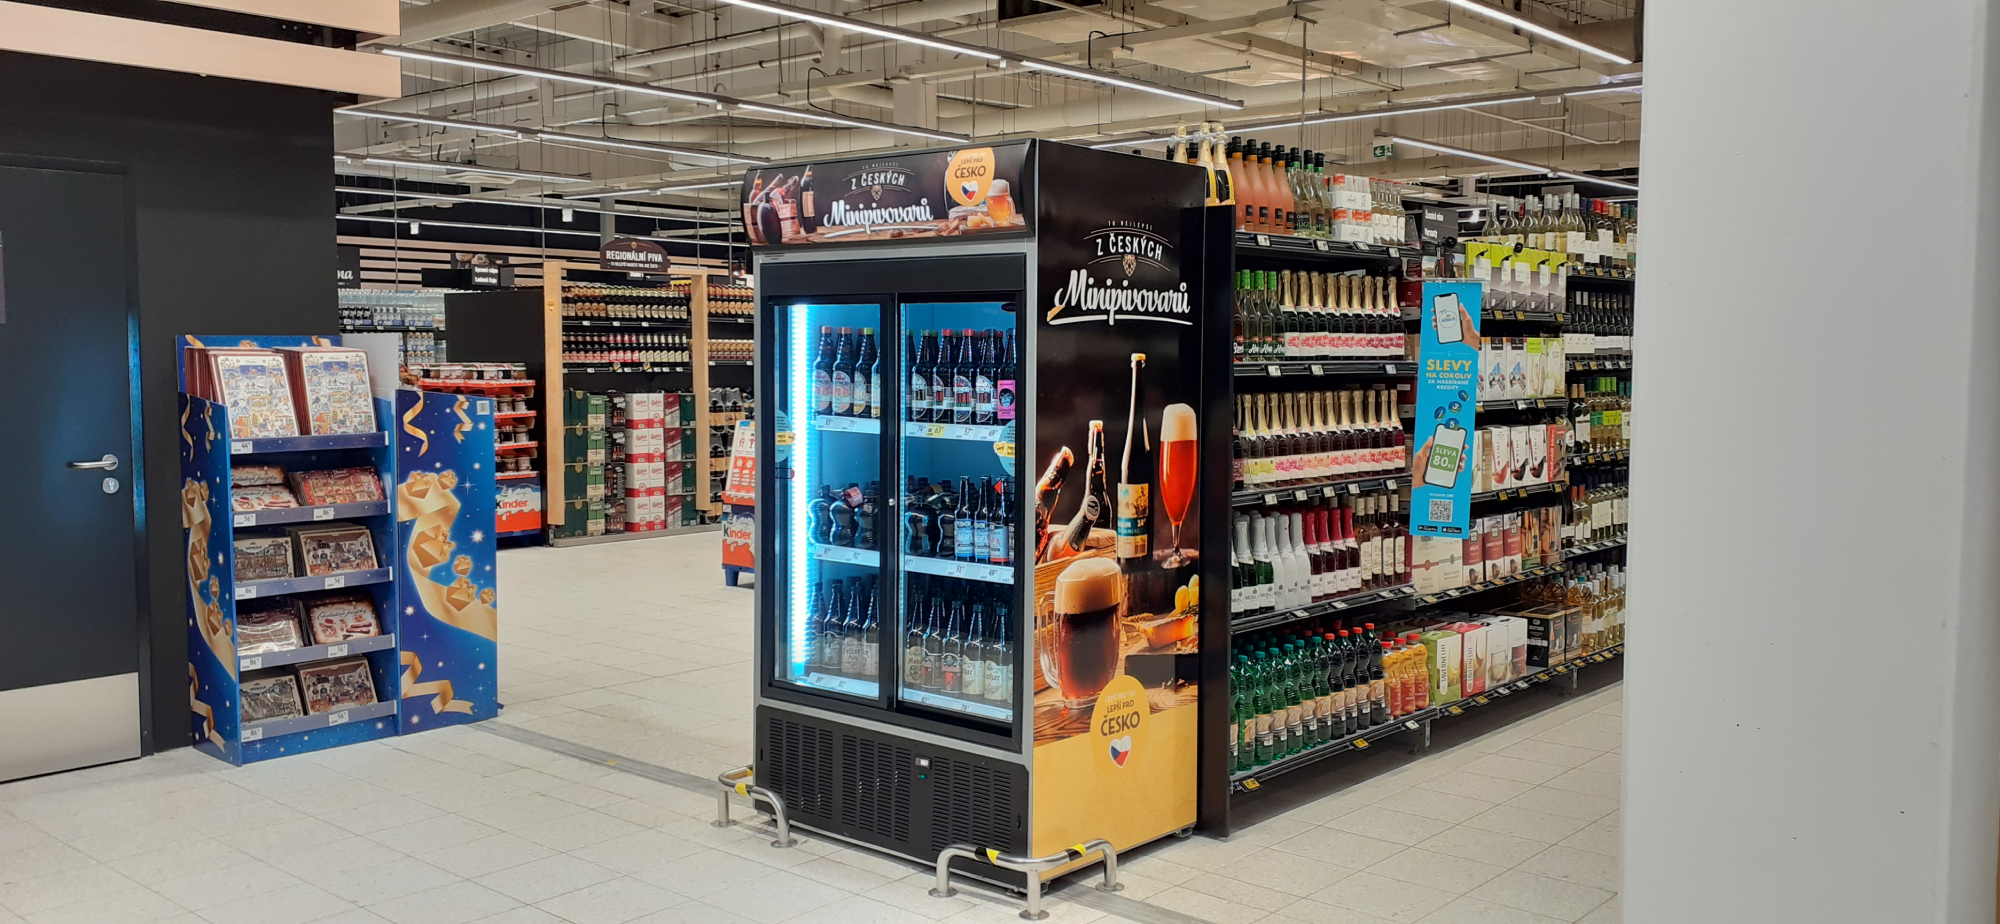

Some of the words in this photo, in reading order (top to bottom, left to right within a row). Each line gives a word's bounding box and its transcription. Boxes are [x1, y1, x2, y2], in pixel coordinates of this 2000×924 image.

[954, 165, 986, 178] ČESKO
[851, 179, 857, 190] Z
[861, 170, 905, 187] ČESKÝCH
[823, 198, 934, 235] Minipivovarů
[1096, 238, 1103, 256] Z
[1109, 233, 1162, 260] ČESKÝCH
[606, 250, 646, 261] REGIONÁLNÍ
[648, 252, 663, 262] PIVA
[1054, 269, 1190, 326] Minipivovarů
[1426, 359, 1472, 371] SLEVY
[1436, 447, 1456, 457] SLEVA
[1433, 456, 1448, 467] 80
[723, 524, 751, 540] Kinder
[1107, 700, 1121, 713] LEPŠÍ
[1122, 700, 1134, 709] PRO
[1100, 711, 1140, 736] ČESKO
